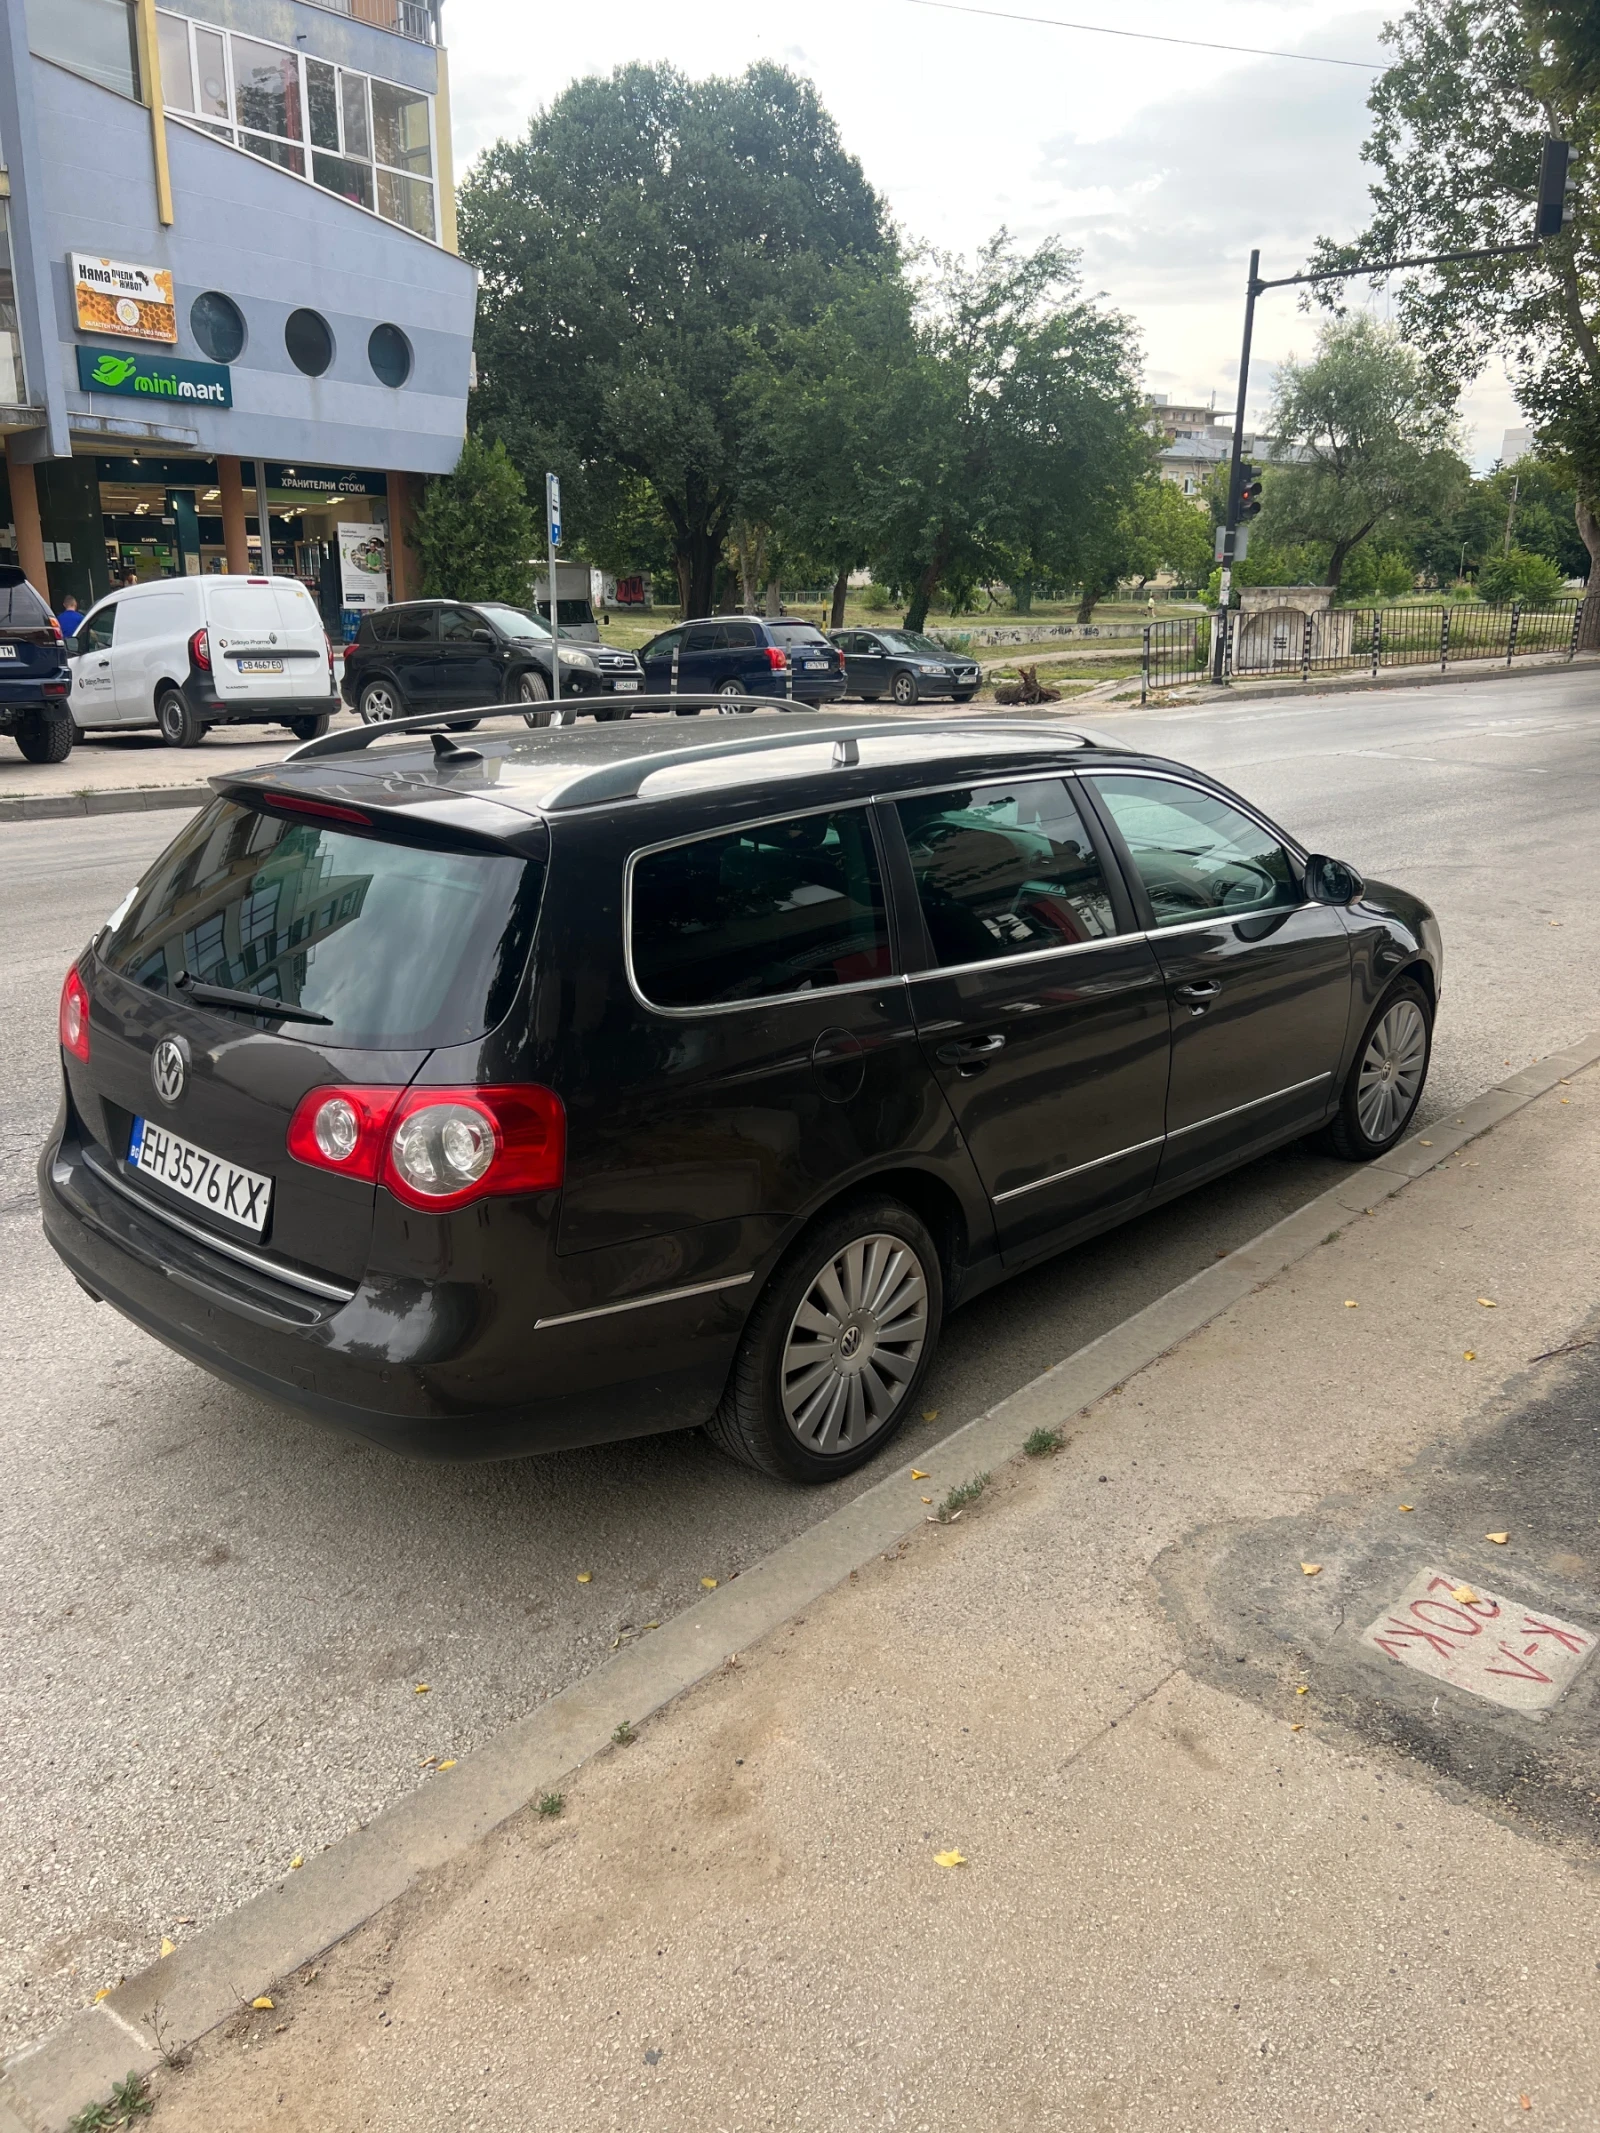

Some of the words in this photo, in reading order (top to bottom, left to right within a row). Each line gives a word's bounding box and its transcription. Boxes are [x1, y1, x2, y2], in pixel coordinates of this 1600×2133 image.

[79, 264, 111, 284] Няма
[111, 269, 134, 281] ПЧЕЛИ
[119, 280, 142, 292] ЖИВОТ
[134, 372, 225, 401] minimart
[281, 478, 336, 491] ХРАНИТЕЛНИ
[338, 483, 366, 493] СТОКИ
